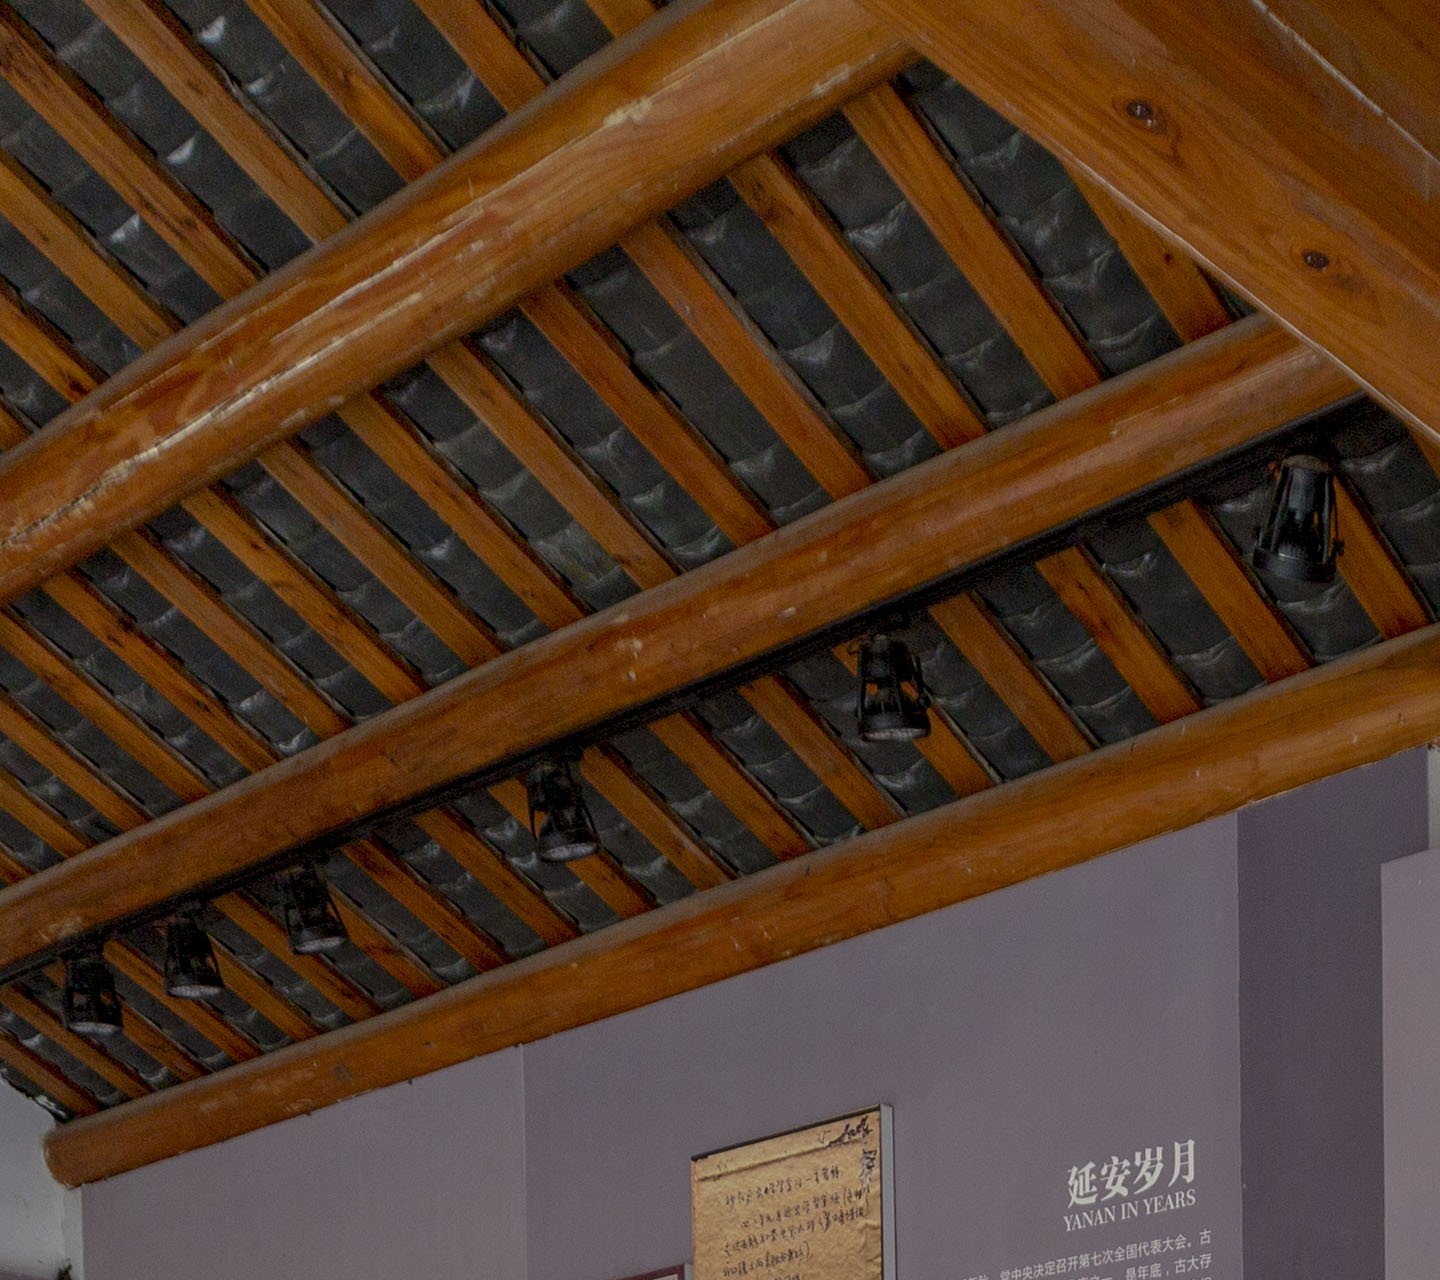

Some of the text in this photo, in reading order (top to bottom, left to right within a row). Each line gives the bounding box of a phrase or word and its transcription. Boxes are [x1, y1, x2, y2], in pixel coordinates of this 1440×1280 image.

[1068, 1139, 1195, 1209] 延安岁月
[1063, 1188, 1196, 1232] YANAN IN YEARS
